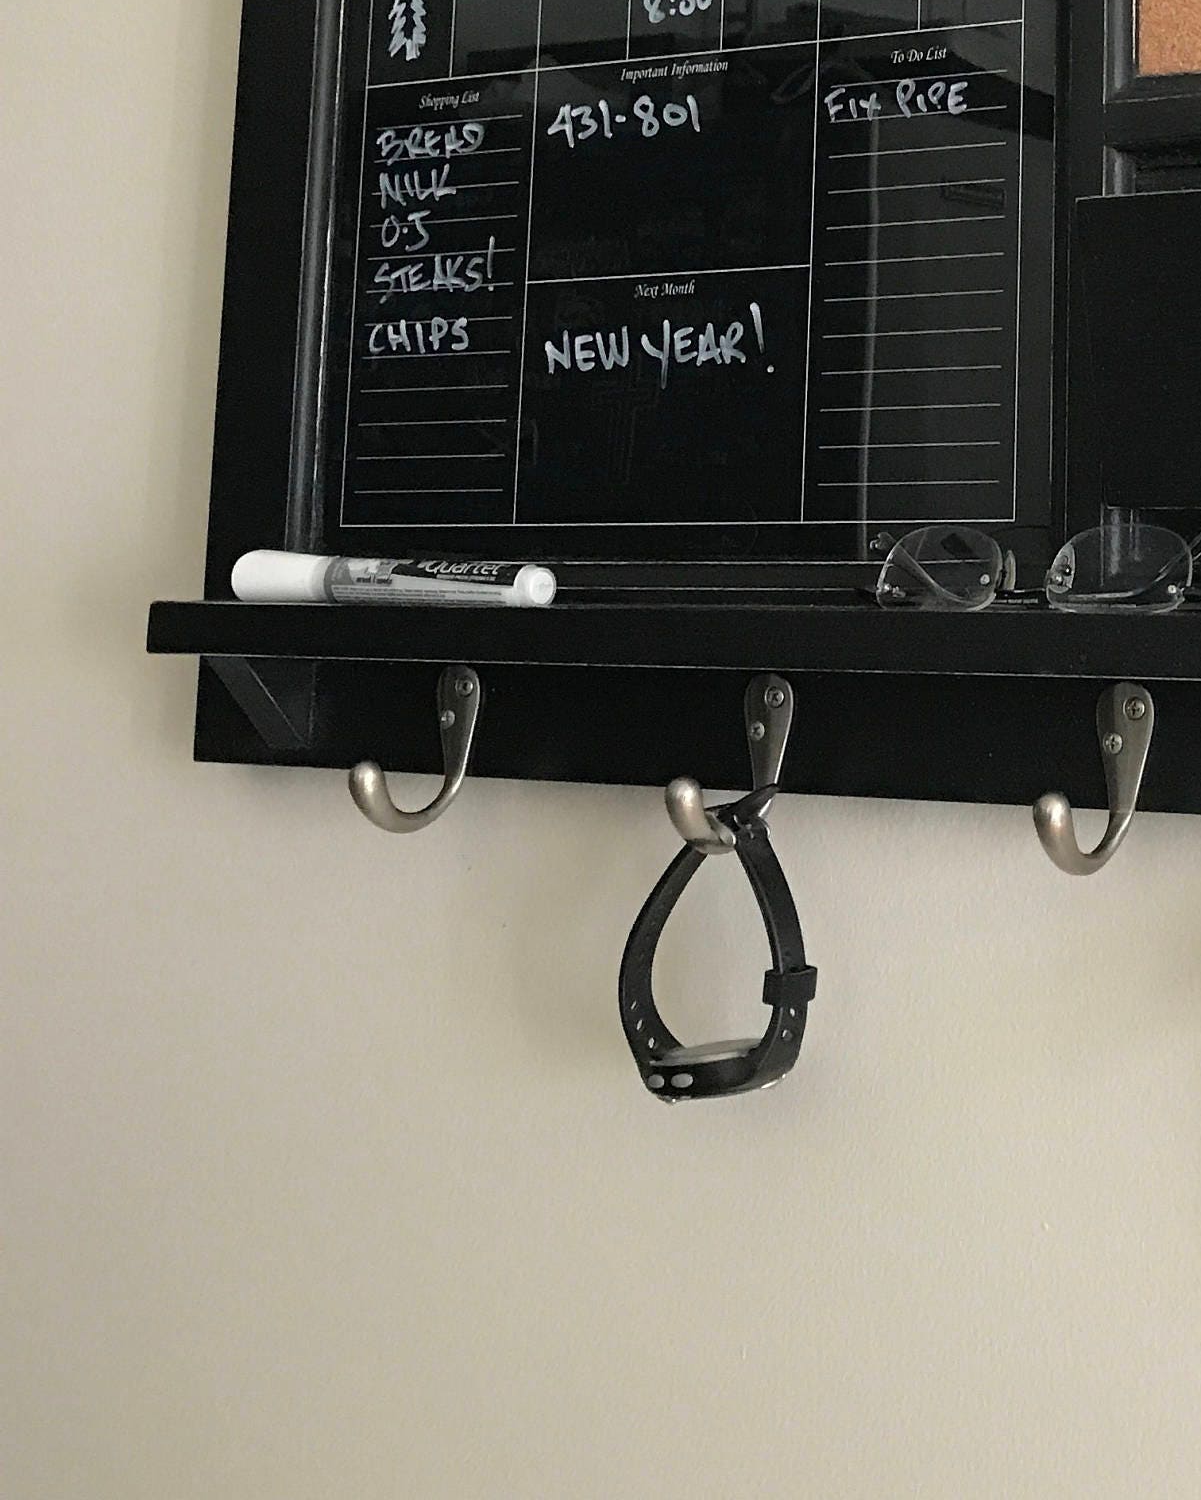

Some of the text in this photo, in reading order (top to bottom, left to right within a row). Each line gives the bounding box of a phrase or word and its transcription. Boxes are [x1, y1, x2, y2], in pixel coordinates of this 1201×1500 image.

[890, 46, 947, 64] To Do List
[620, 59, 729, 84] Important Information
[418, 90, 480, 111] Shopping List
[547, 94, 700, 148] 431-801
[374, 236, 496, 305] STEAKS!
[634, 279, 696, 299] Next Month
[368, 317, 469, 354] CHIPS
[544, 301, 774, 390] NEW YEAR!
[424, 560, 501, 575] Quartet
